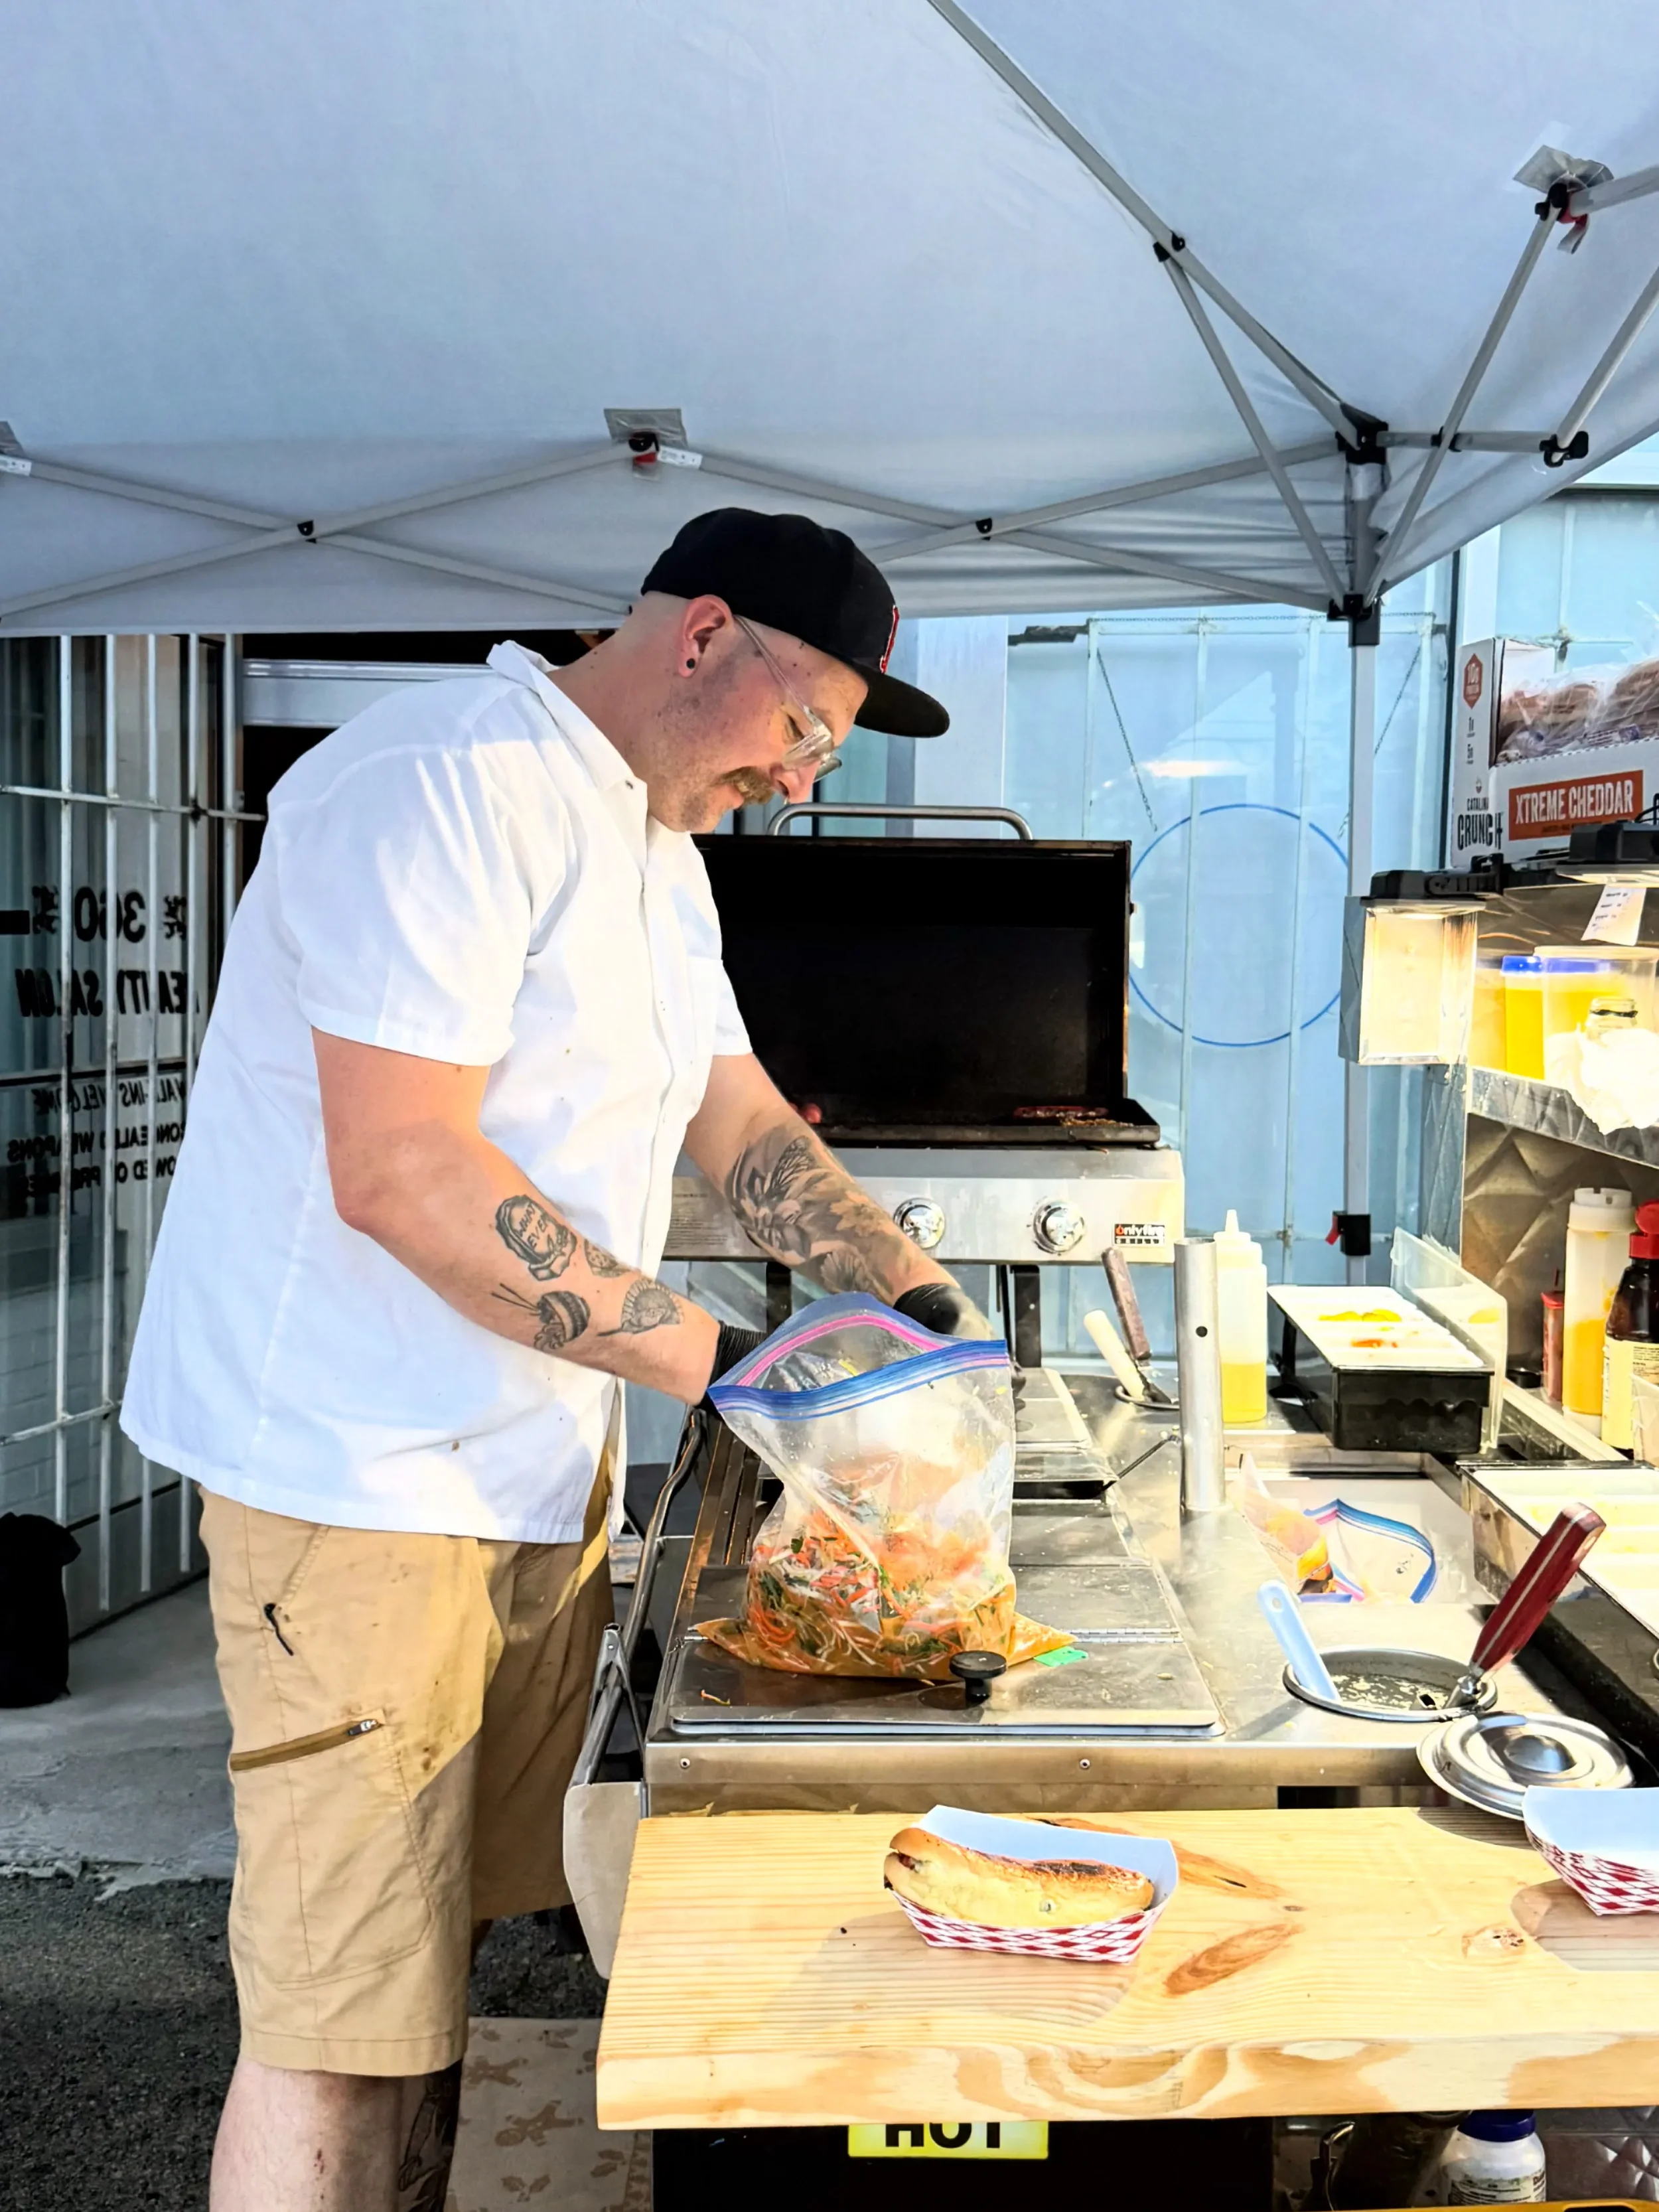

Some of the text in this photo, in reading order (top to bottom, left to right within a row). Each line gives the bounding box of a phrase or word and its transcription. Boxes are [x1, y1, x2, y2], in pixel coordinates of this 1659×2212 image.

[1516, 779, 1634, 824] XTREME CHEDDAR
[1457, 812, 1502, 851] CRUNCH
